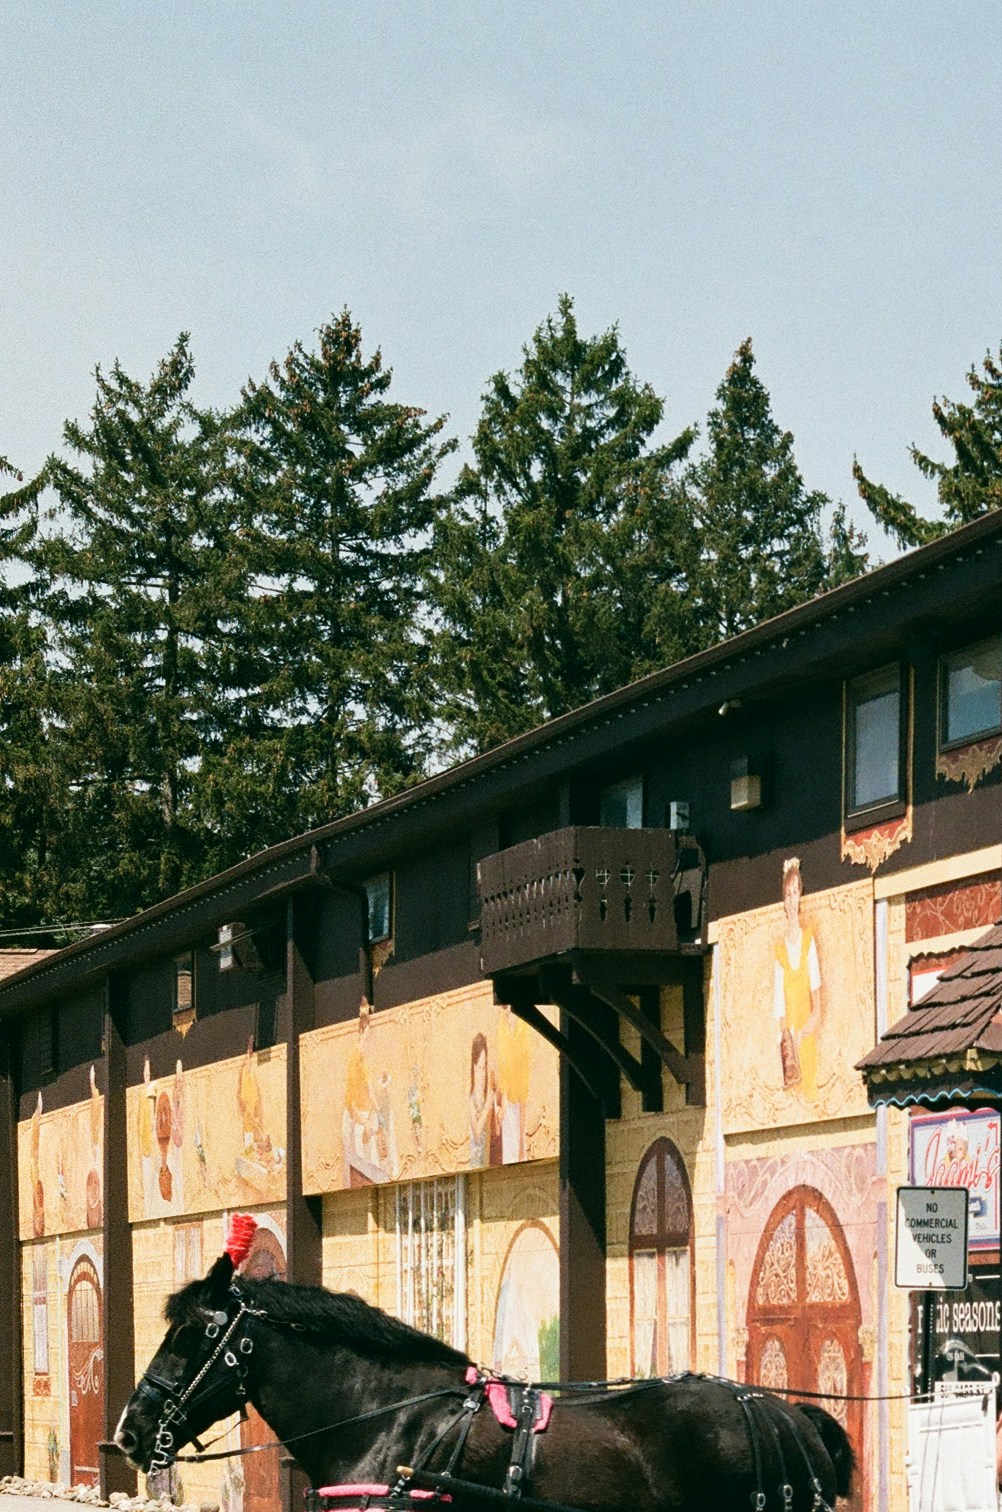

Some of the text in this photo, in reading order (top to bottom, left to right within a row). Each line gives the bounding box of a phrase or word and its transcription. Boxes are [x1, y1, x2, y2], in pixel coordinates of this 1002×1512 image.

[926, 1202, 938, 1213] NO
[905, 1218, 958, 1229] COMMERCIAL
[913, 1233, 952, 1244] VEHICLES
[925, 1249, 937, 1259] OR
[916, 1263, 945, 1274] BUSES
